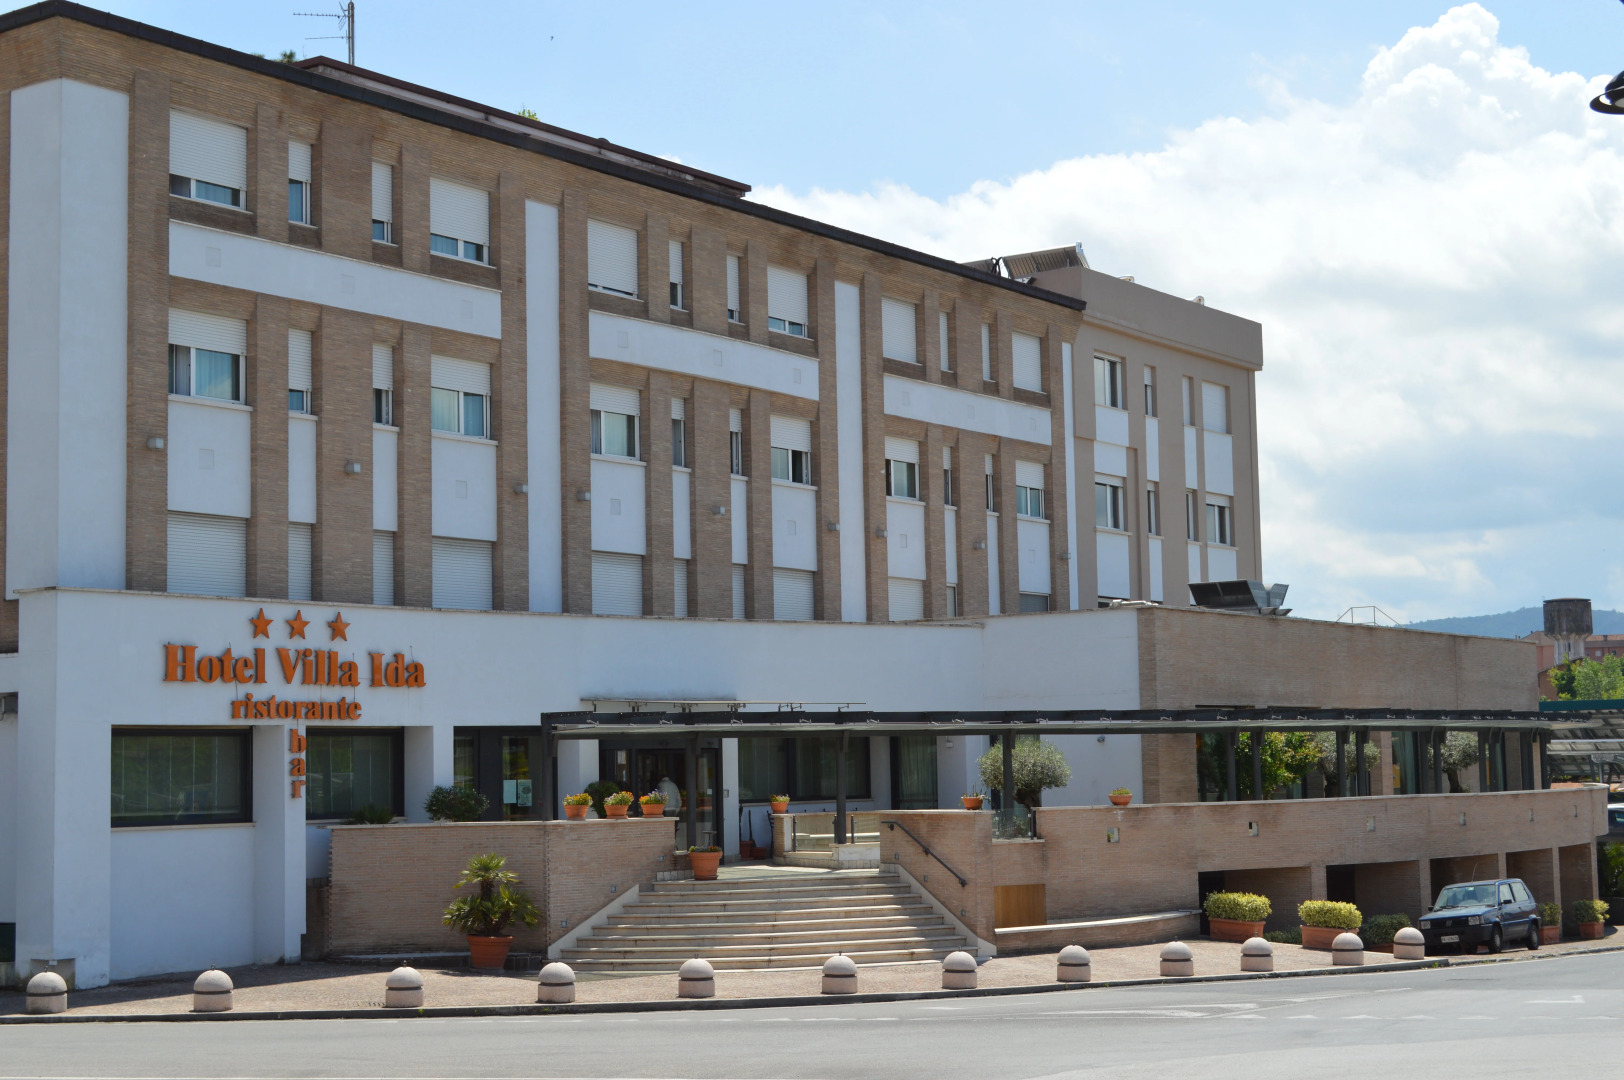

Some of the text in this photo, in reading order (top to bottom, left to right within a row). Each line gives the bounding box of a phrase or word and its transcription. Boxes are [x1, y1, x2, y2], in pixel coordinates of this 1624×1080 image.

[164, 644, 427, 688] Hotel Villa Ida
[231, 693, 362, 720] ristorante
[289, 728, 307, 799] bar
